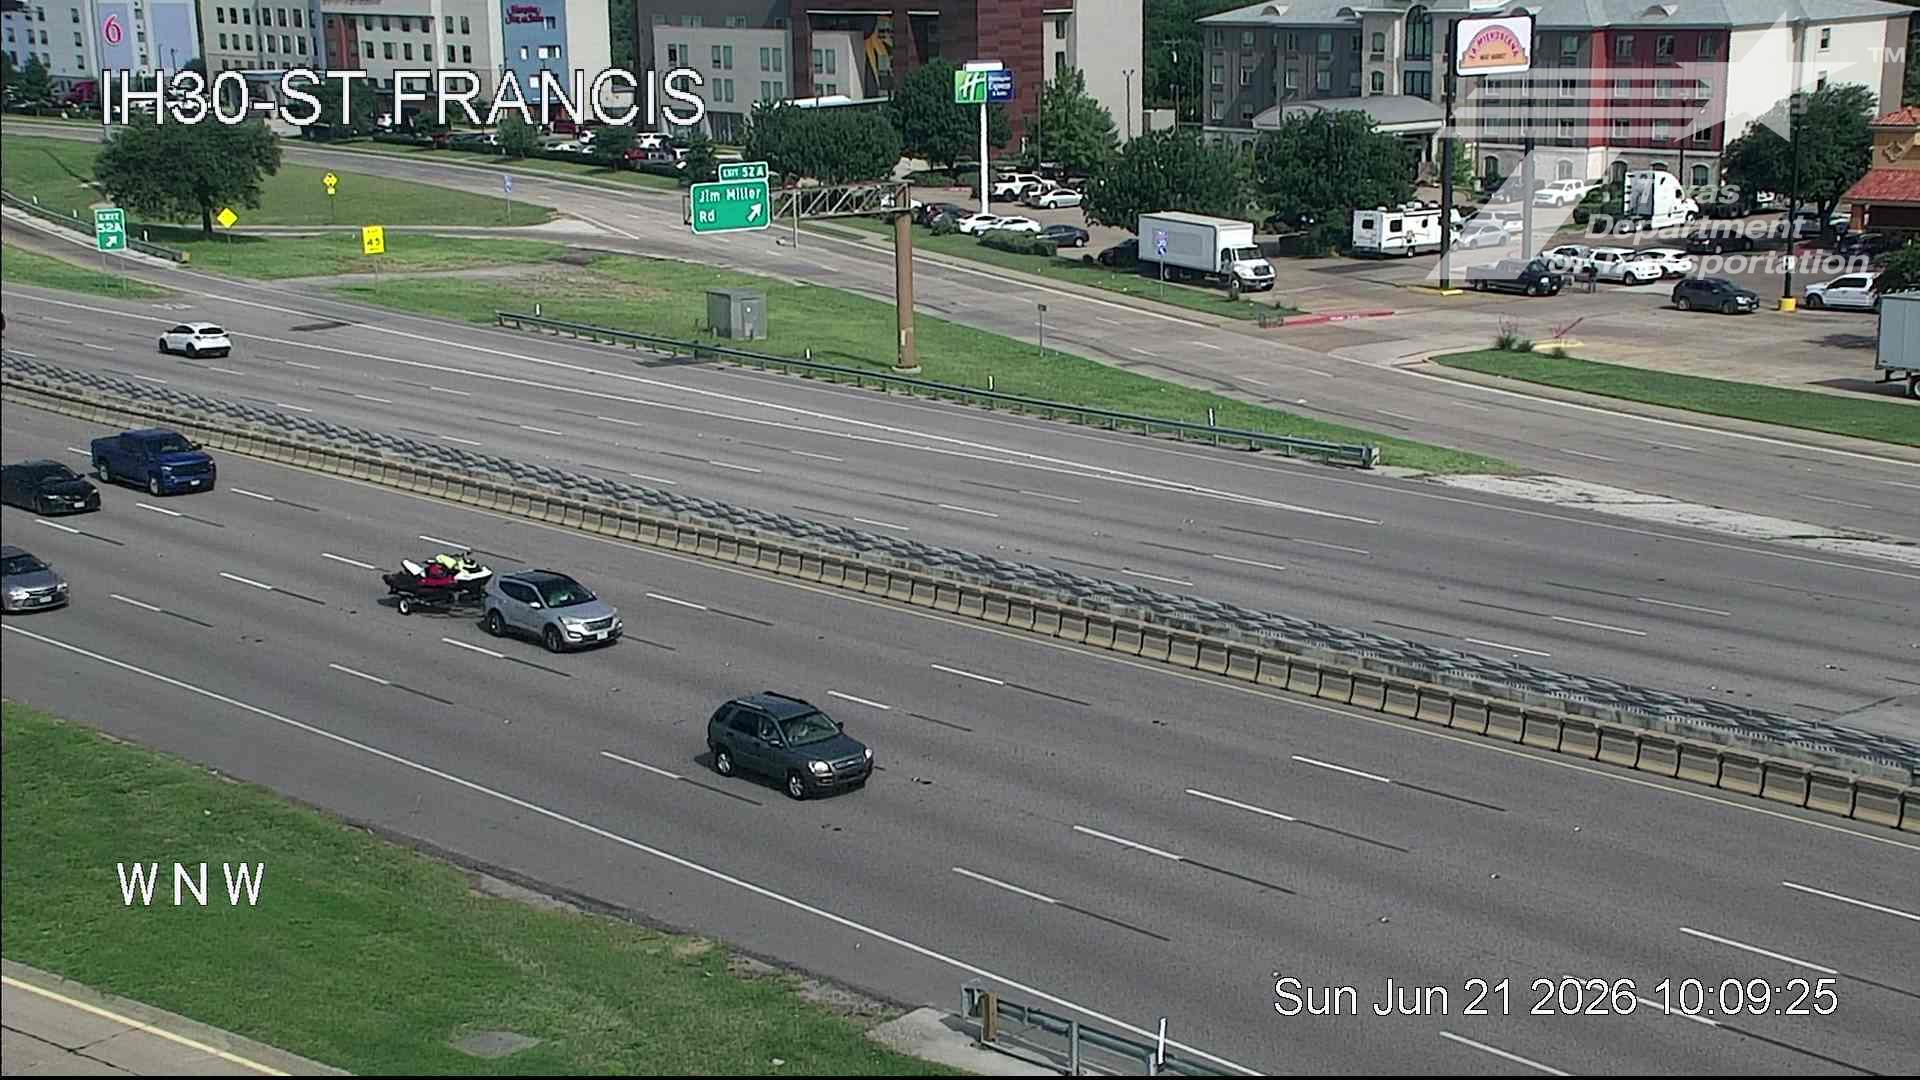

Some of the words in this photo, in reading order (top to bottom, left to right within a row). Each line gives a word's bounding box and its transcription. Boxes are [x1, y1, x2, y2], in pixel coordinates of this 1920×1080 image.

[103, 14, 123, 45] 6
[699, 189, 720, 203] Jim
[726, 188, 761, 201] Miller
[699, 210, 715, 222] Rd
